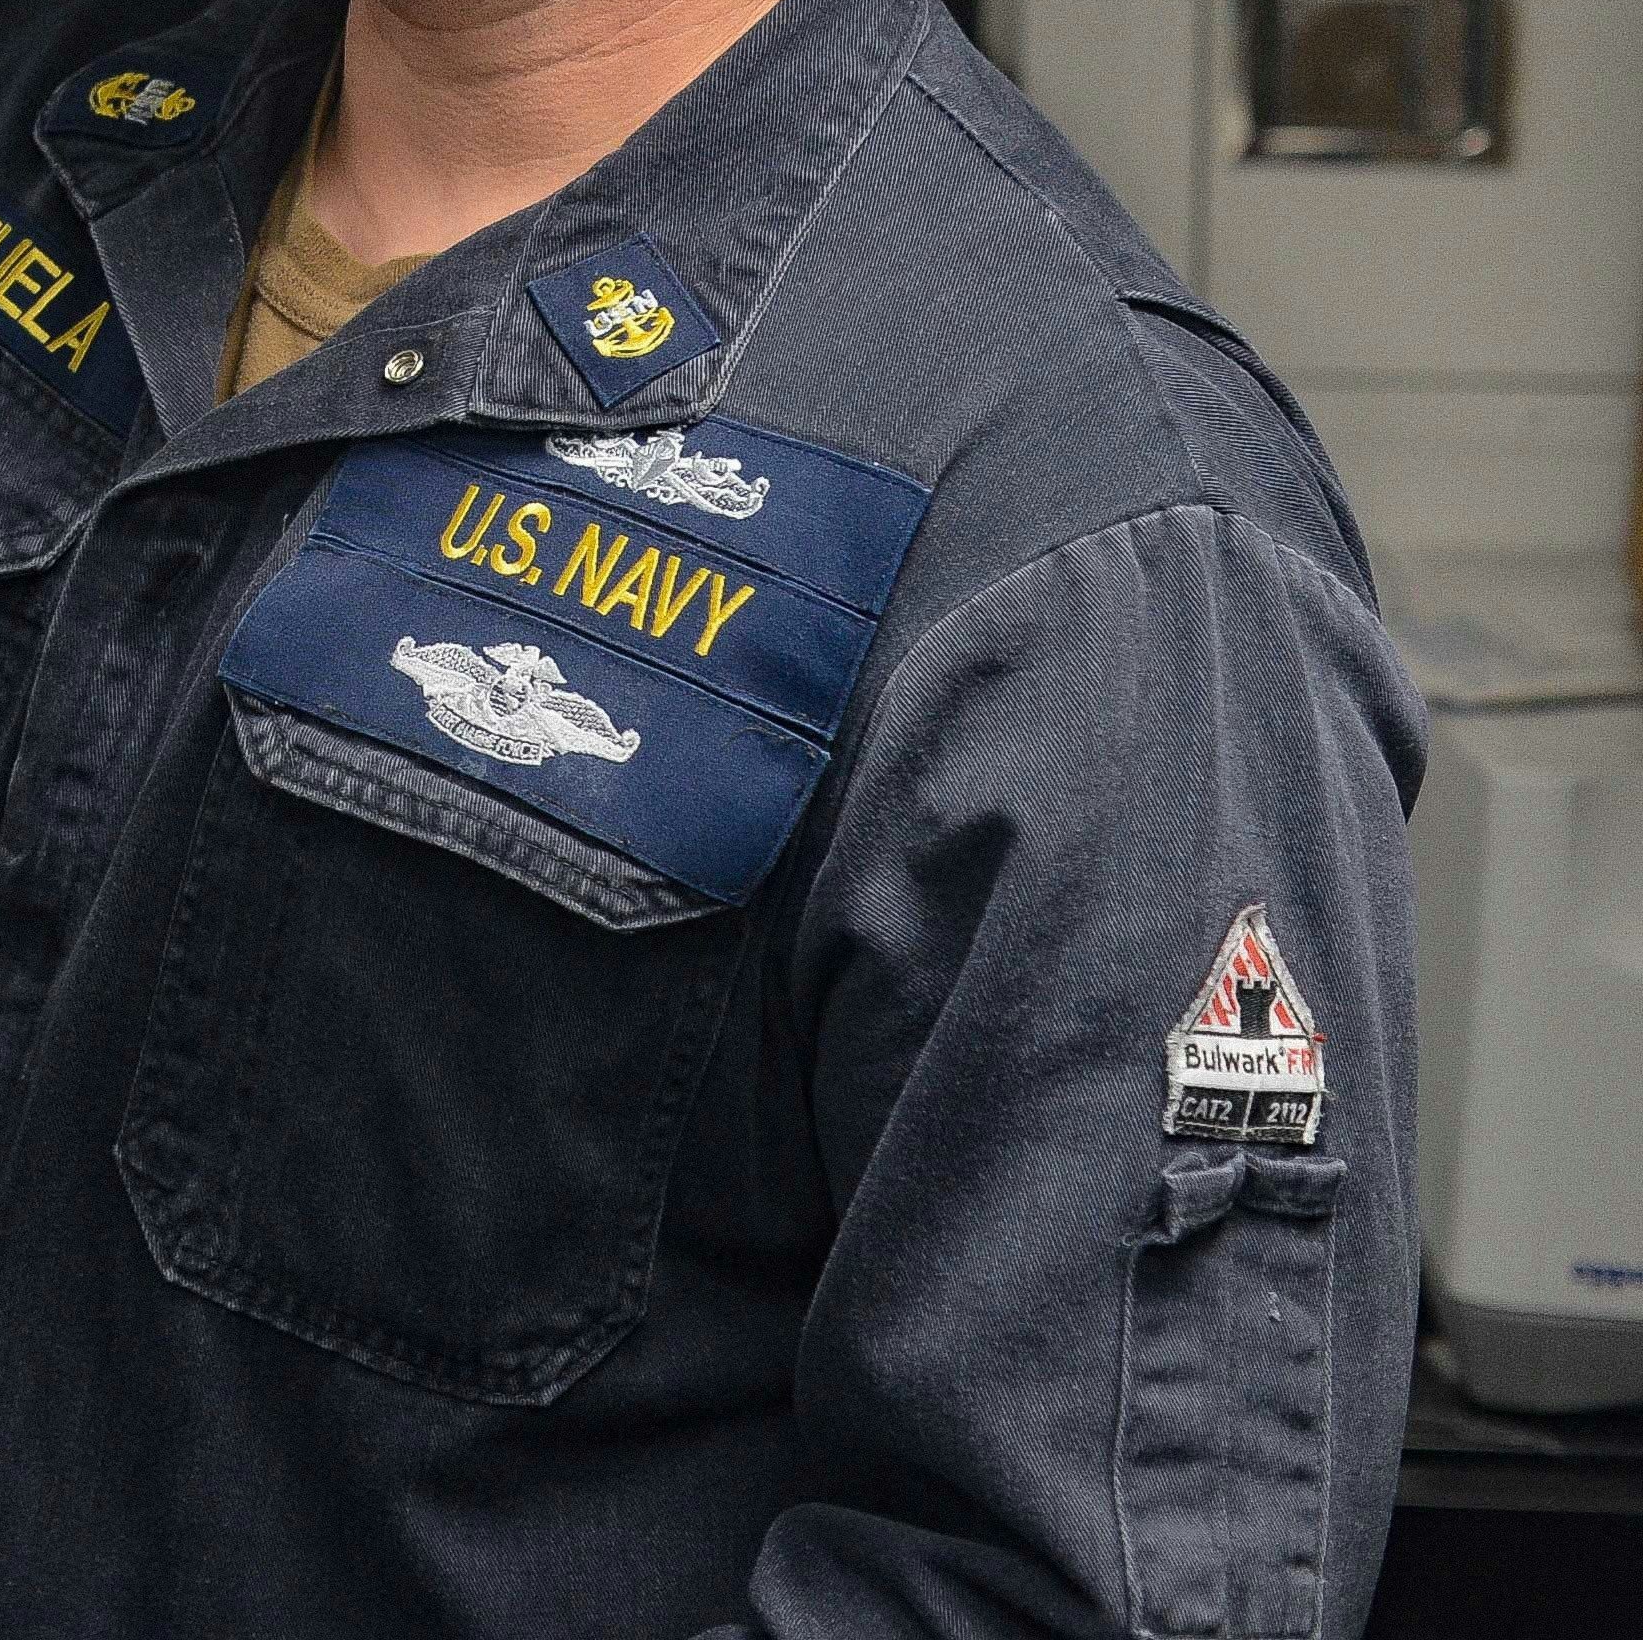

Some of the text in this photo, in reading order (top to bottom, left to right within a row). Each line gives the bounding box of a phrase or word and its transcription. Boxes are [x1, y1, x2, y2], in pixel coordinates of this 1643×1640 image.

[440, 483, 756, 657] U.S. NAVY
[1286, 1047, 1315, 1076] FR
